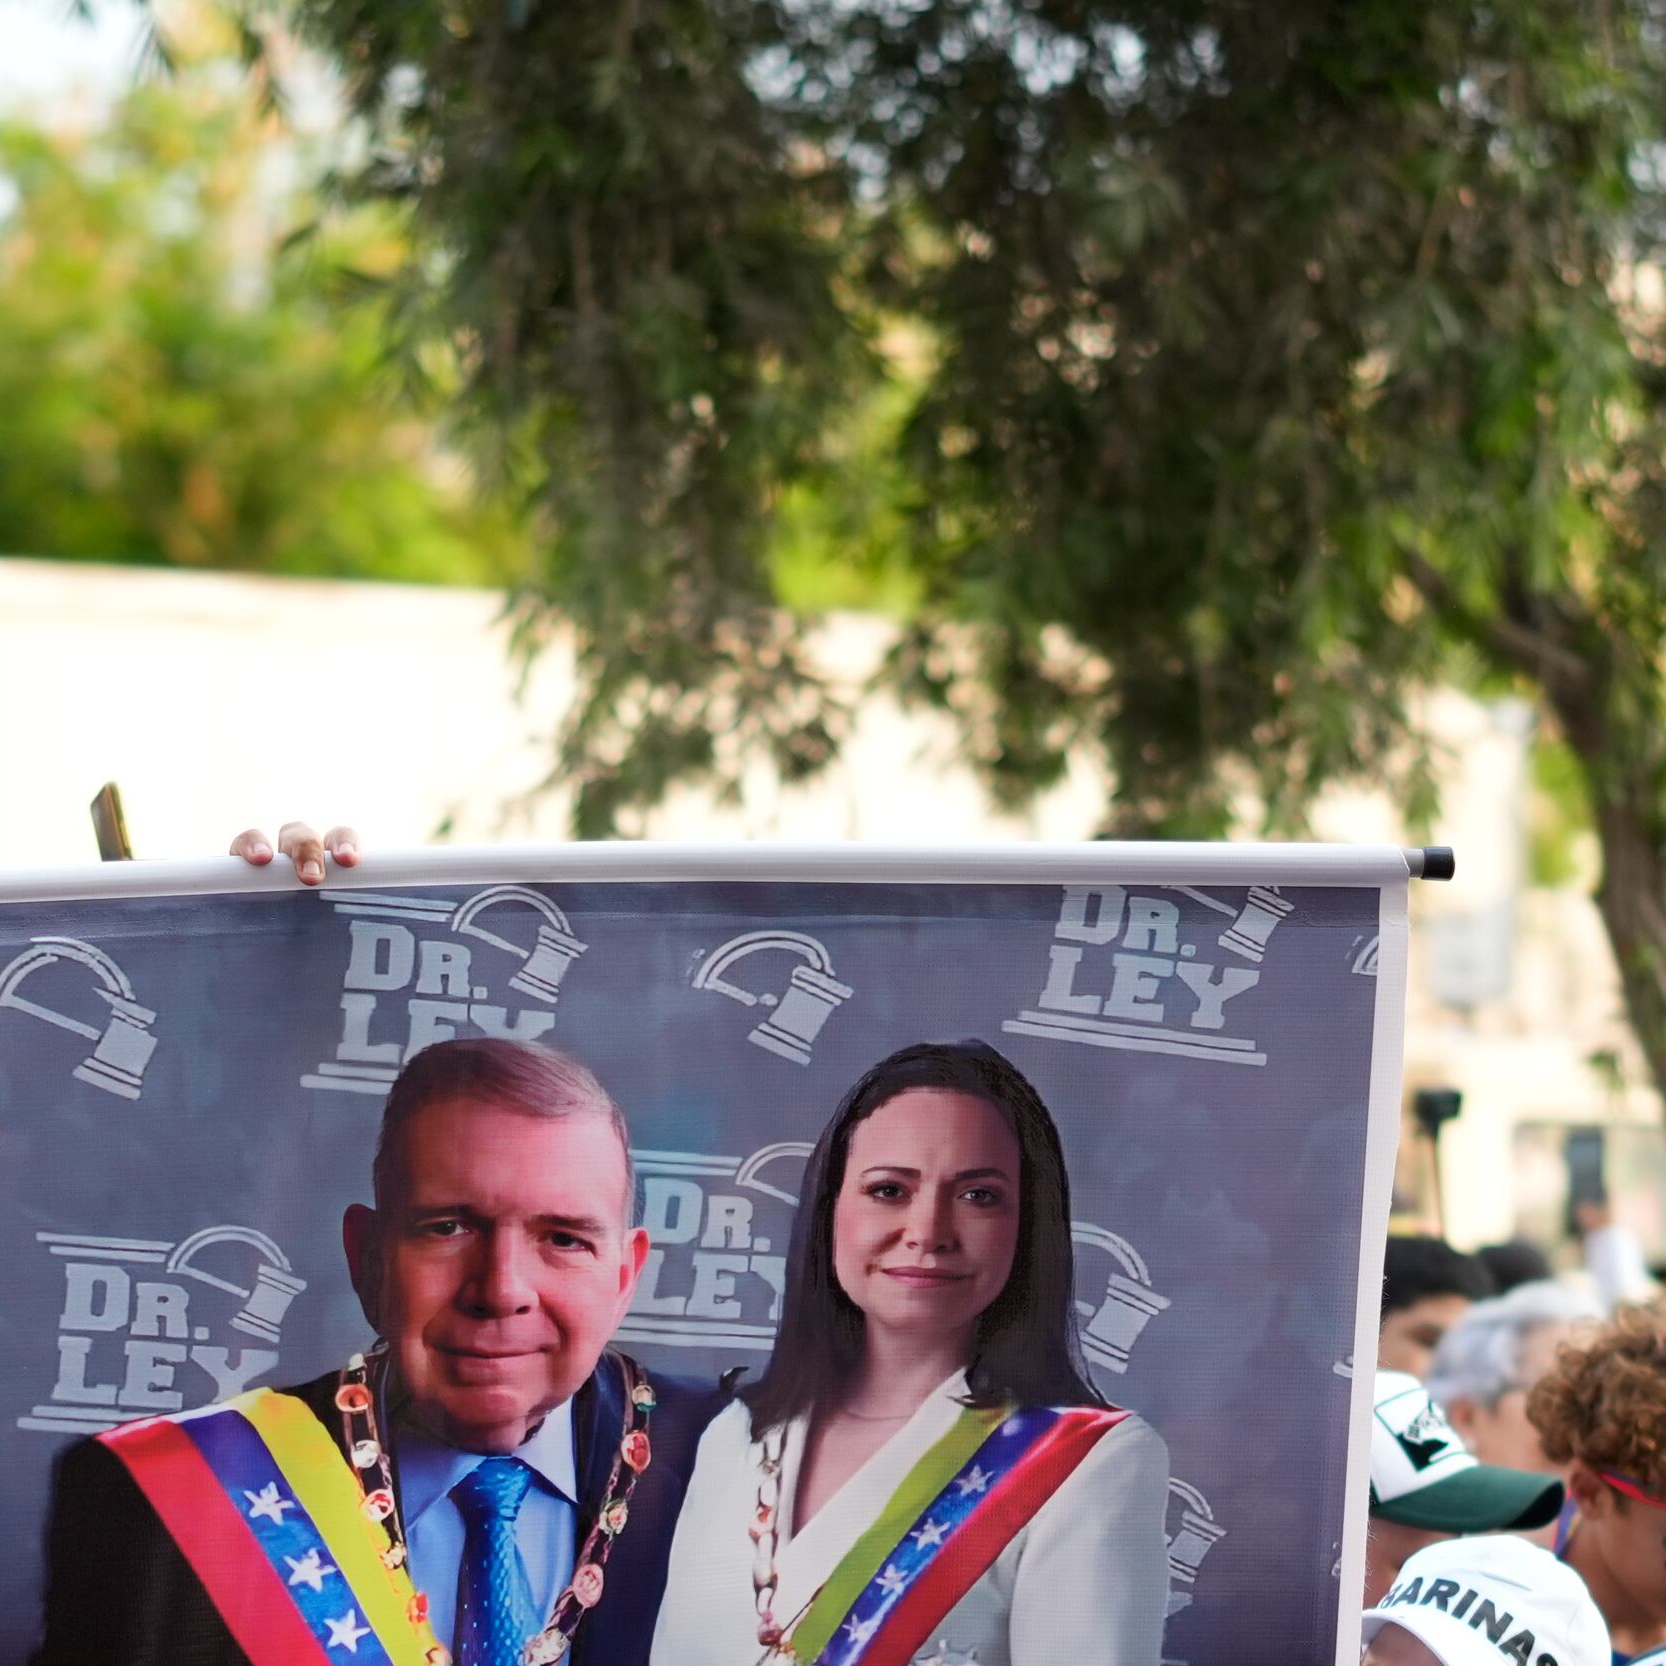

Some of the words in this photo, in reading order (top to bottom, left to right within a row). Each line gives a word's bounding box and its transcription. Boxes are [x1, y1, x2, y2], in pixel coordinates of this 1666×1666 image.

[343, 920, 488, 999] DR.
[1038, 945, 1261, 1029] LEY
[643, 1178, 772, 1252] DR.
[59, 1262, 210, 1340] DR.
[51, 1335, 280, 1411] LEY
